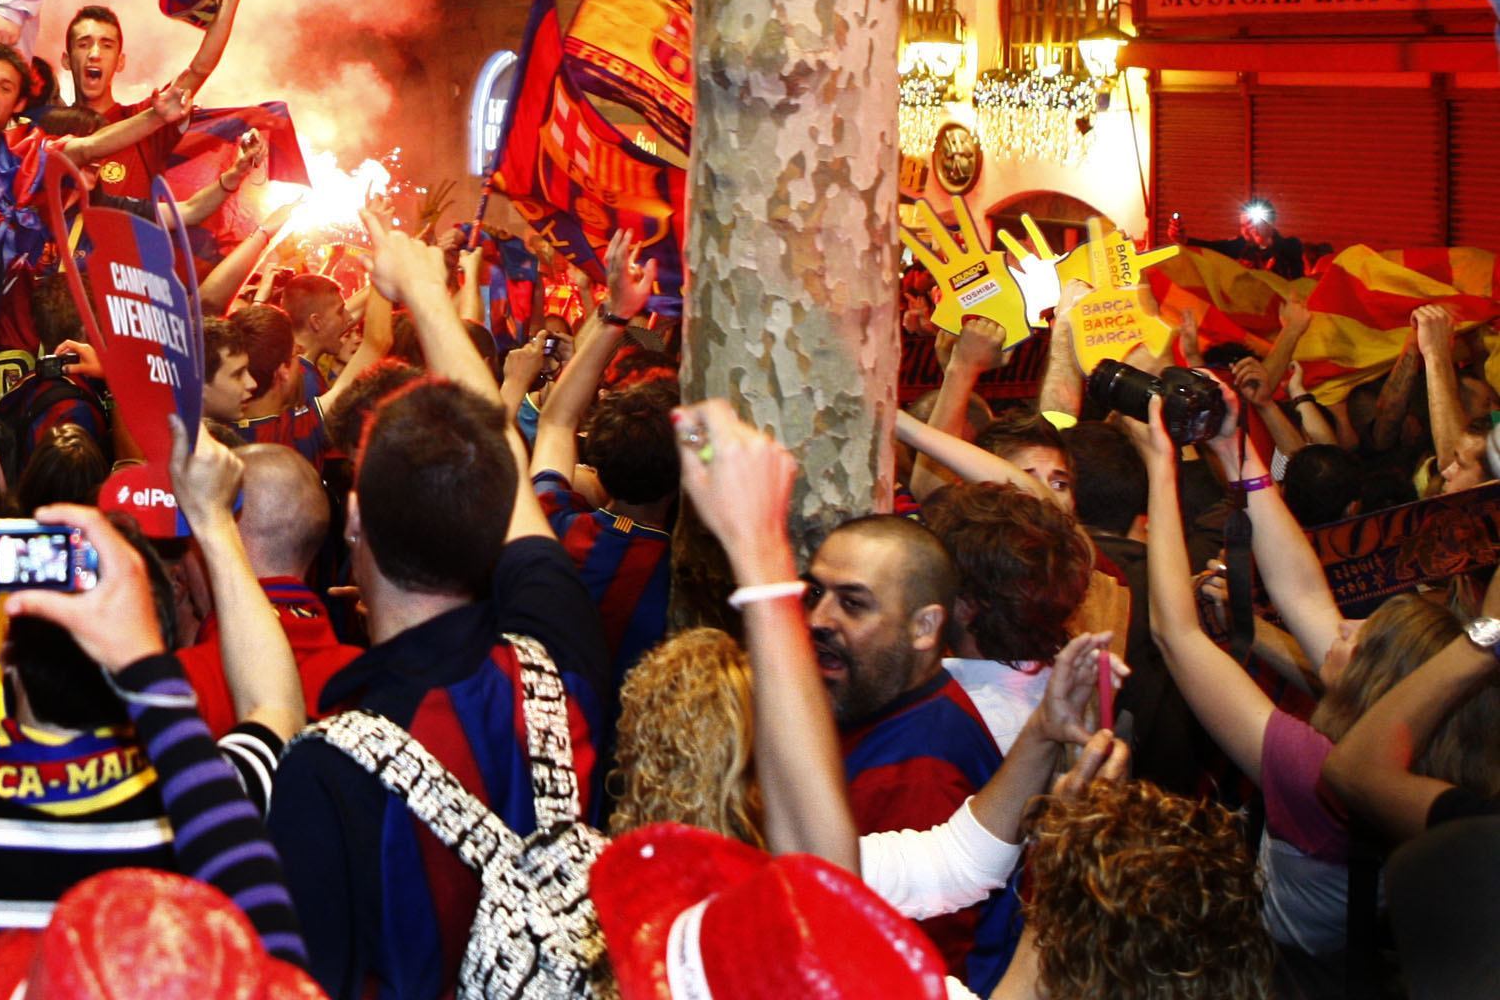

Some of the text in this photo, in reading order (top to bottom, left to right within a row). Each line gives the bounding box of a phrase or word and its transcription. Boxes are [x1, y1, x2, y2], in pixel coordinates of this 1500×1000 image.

[961, 282, 997, 302] TOSHIBA
[105, 294, 189, 357] WEMBLEY
[147, 354, 181, 389] 2011
